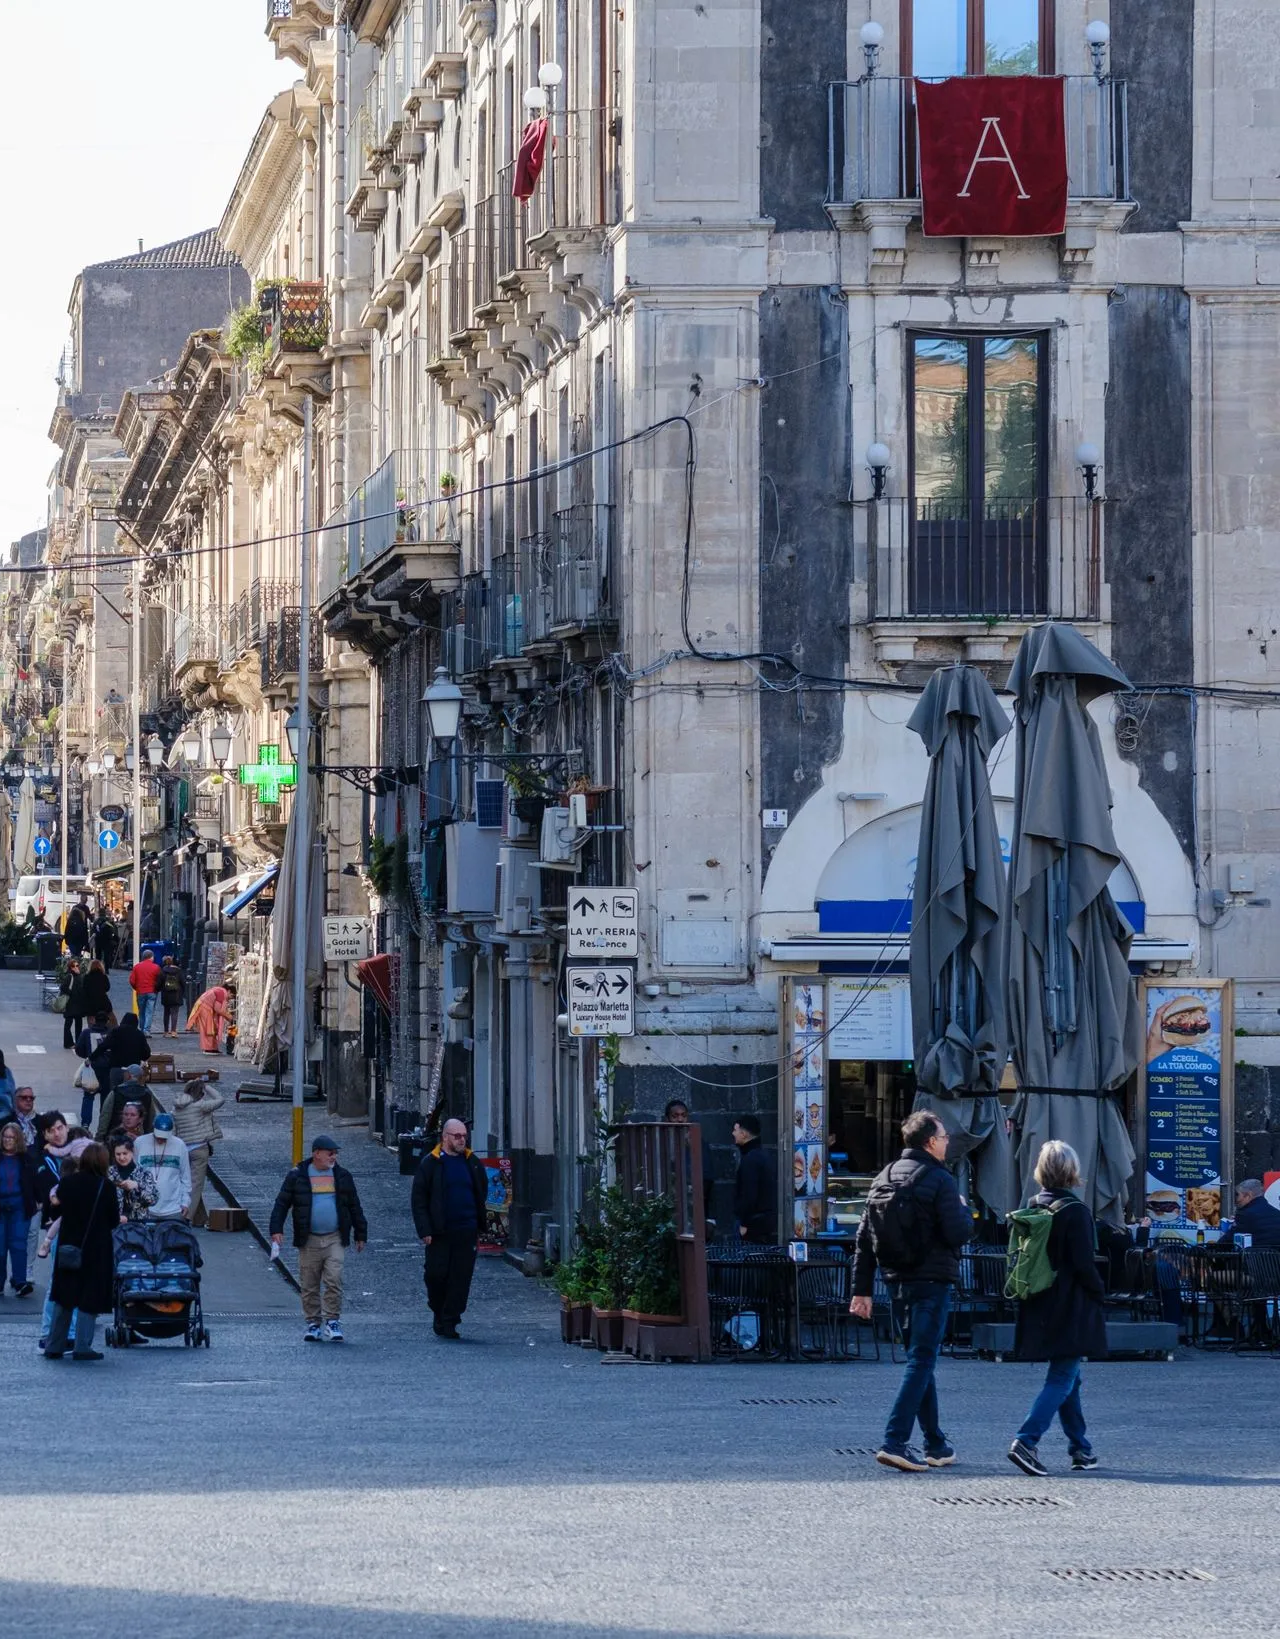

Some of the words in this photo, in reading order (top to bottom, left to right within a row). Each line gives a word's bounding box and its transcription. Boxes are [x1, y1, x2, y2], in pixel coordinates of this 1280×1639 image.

[956, 117, 1031, 199] A
[570, 928, 582, 936] LA
[586, 928, 636, 936] VRERIA
[572, 1002, 598, 1011] Palazzo
[576, 1014, 594, 1022] Luxury
[1203, 1076, 1218, 1086] €25
[1158, 1084, 1164, 1093] 1
[1157, 1119, 1164, 1128] 2
[1203, 1126, 1218, 1136] €25
[1157, 1160, 1164, 1171] 3
[1203, 1168, 1217, 1177] €50
